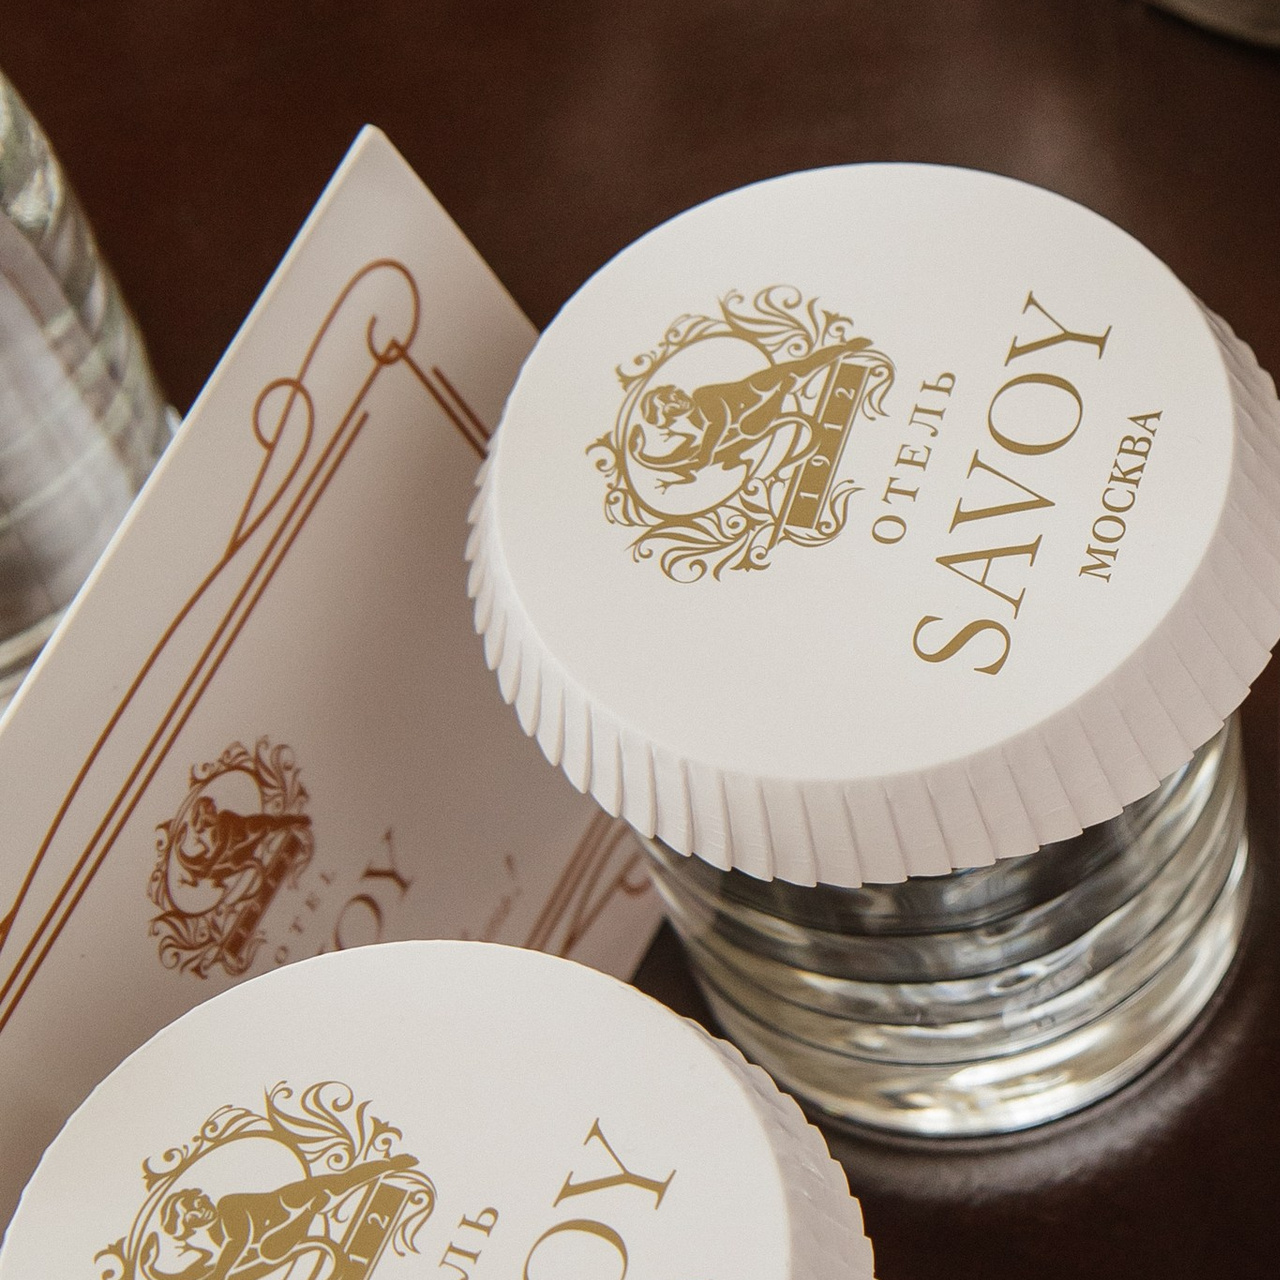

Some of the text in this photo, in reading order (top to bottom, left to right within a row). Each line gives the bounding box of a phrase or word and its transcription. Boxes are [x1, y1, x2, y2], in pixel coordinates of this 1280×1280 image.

[799, 386, 856, 501] 1912
[872, 371, 957, 545] ОТЕЛЬ
[912, 291, 1113, 676] SAVOY
[1079, 410, 1163, 583] МОСКВА
